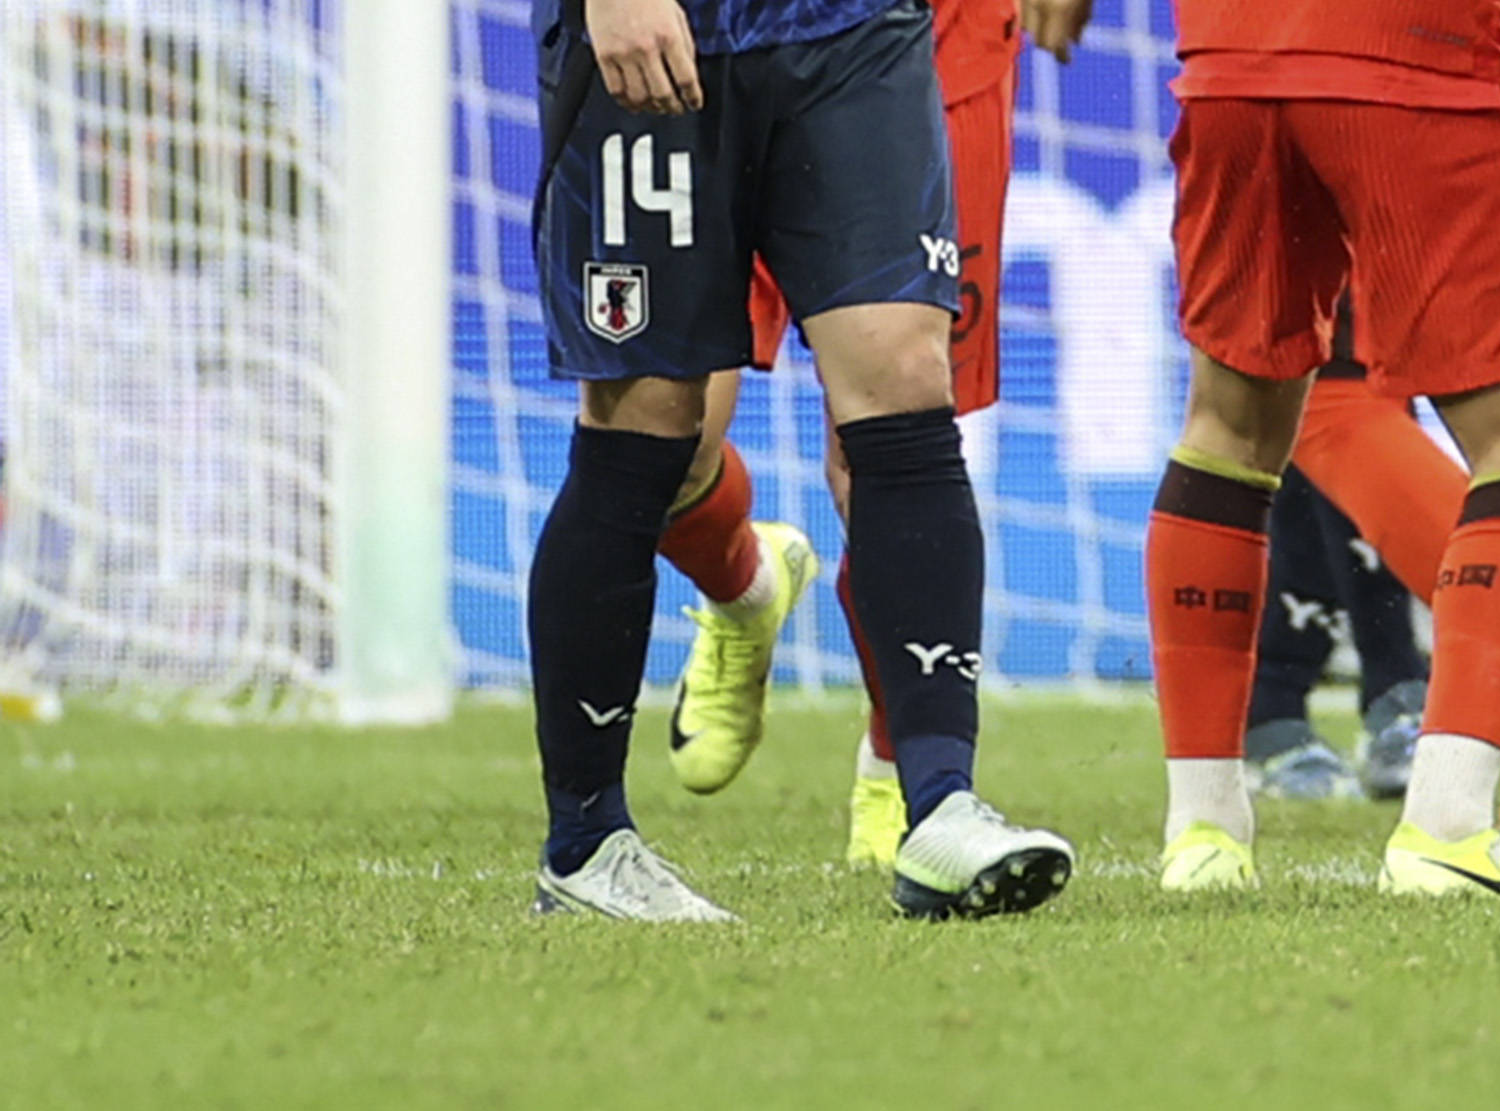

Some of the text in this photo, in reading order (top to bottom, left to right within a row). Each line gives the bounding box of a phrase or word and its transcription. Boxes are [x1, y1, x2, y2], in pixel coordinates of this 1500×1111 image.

[602, 133, 693, 246] 14
[919, 233, 959, 277] Y-3
[904, 642, 983, 680] Y-3
